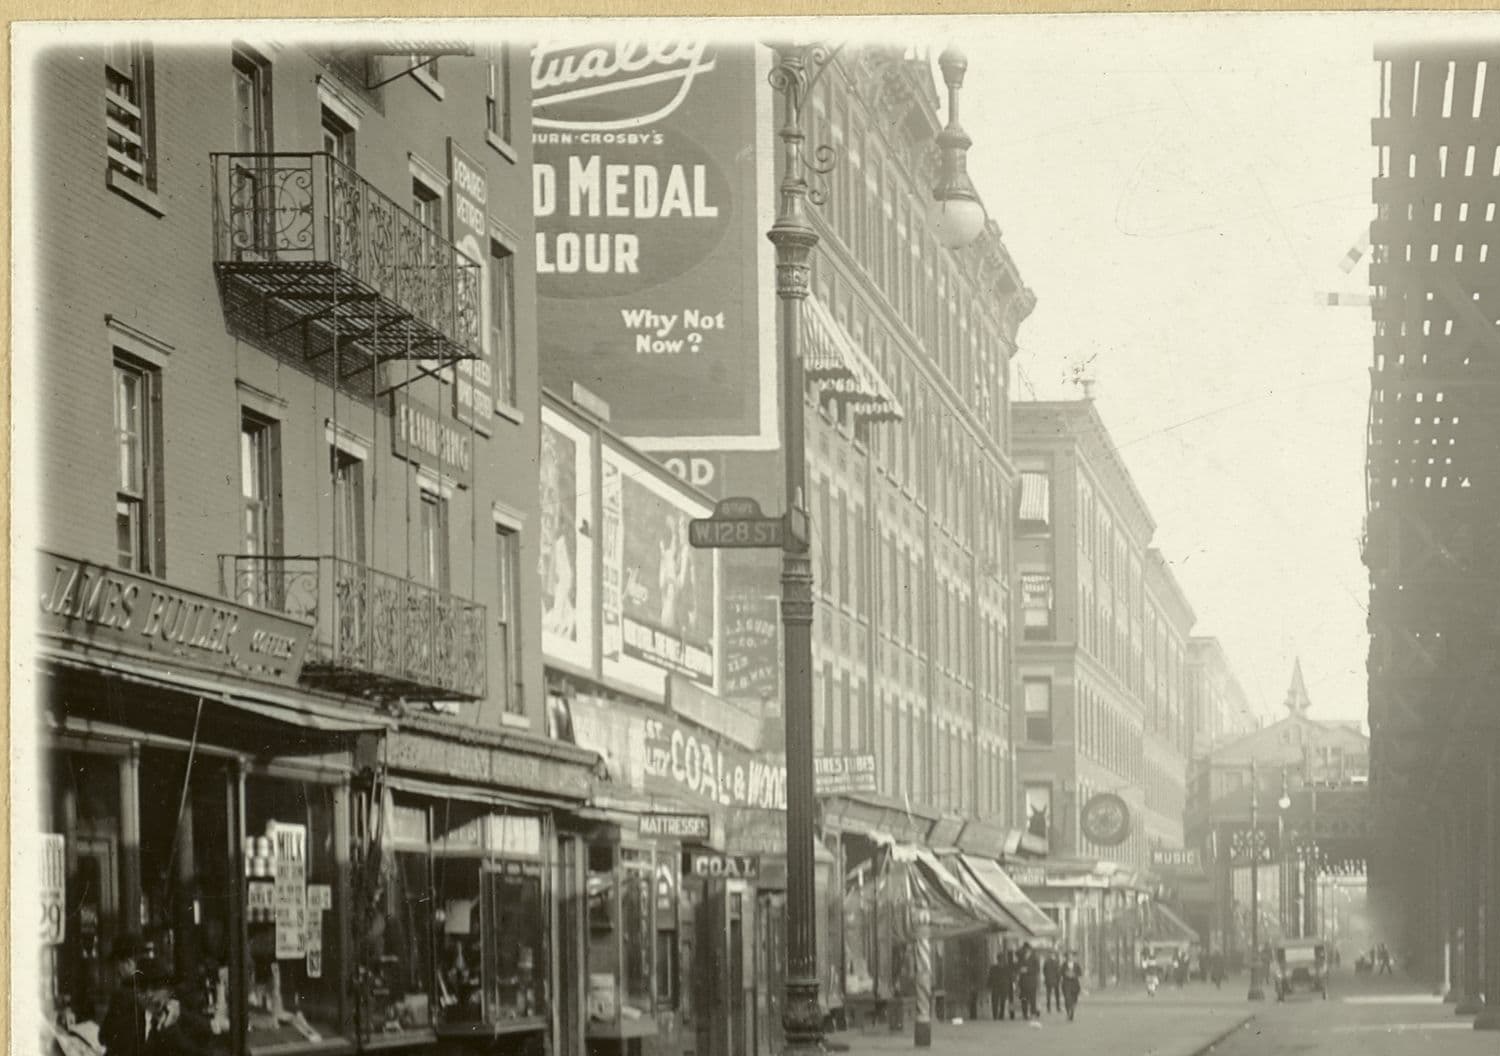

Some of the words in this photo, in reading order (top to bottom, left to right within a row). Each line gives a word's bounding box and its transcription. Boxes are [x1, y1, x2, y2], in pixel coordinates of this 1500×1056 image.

[532, 164, 556, 217] D
[569, 155, 719, 218] MEDAL
[536, 232, 639, 273] LOUR
[621, 309, 678, 337] Why
[683, 309, 726, 329] Not
[40, 564, 139, 632] JAMES
[141, 592, 239, 653] BUTLER
[672, 729, 731, 805] COAL
[734, 765, 745, 801] &
[640, 816, 709, 836] MATTRESSES
[696, 855, 756, 877] COAL
[1154, 850, 1194, 865] MUSIC
